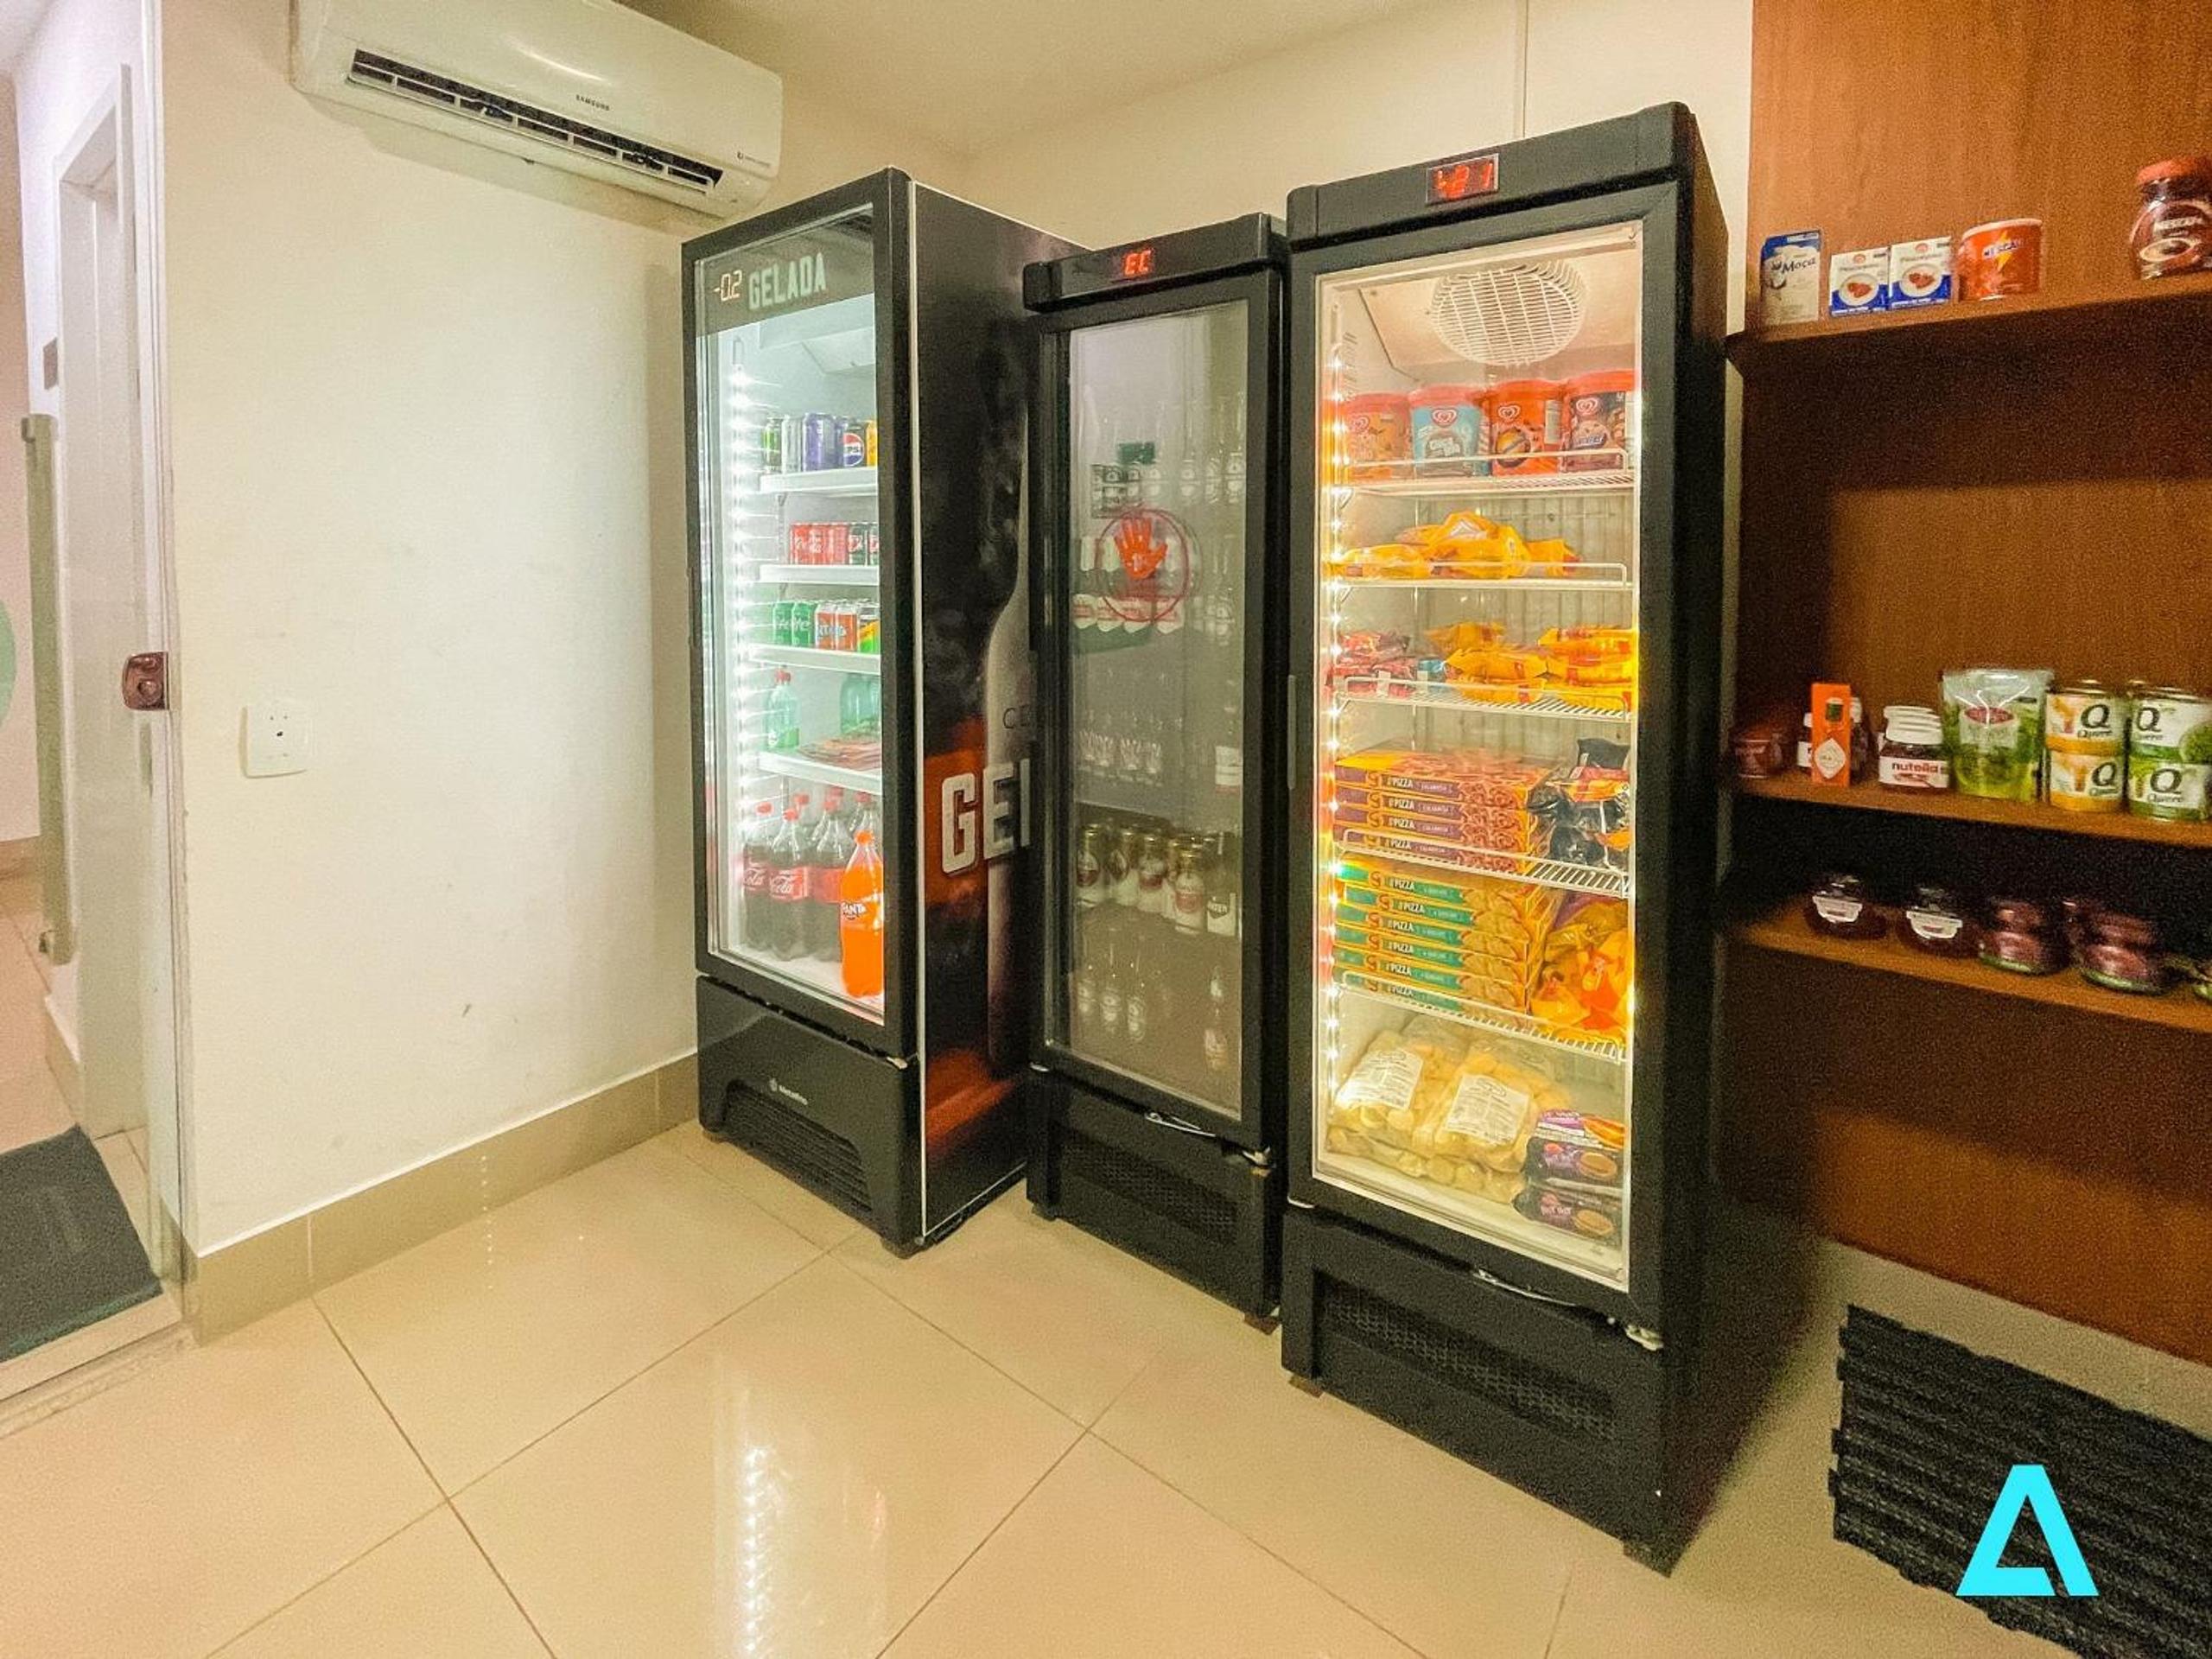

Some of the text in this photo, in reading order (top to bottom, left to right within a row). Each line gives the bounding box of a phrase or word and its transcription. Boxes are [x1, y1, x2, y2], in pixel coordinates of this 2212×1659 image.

[748, 251, 827, 310] GELADA
[2080, 703, 2111, 729] Q
[2136, 707, 2162, 733] Q
[1891, 760, 1939, 774] nutella
[2091, 761, 2118, 787] Q
[2149, 768, 2183, 795] Q
